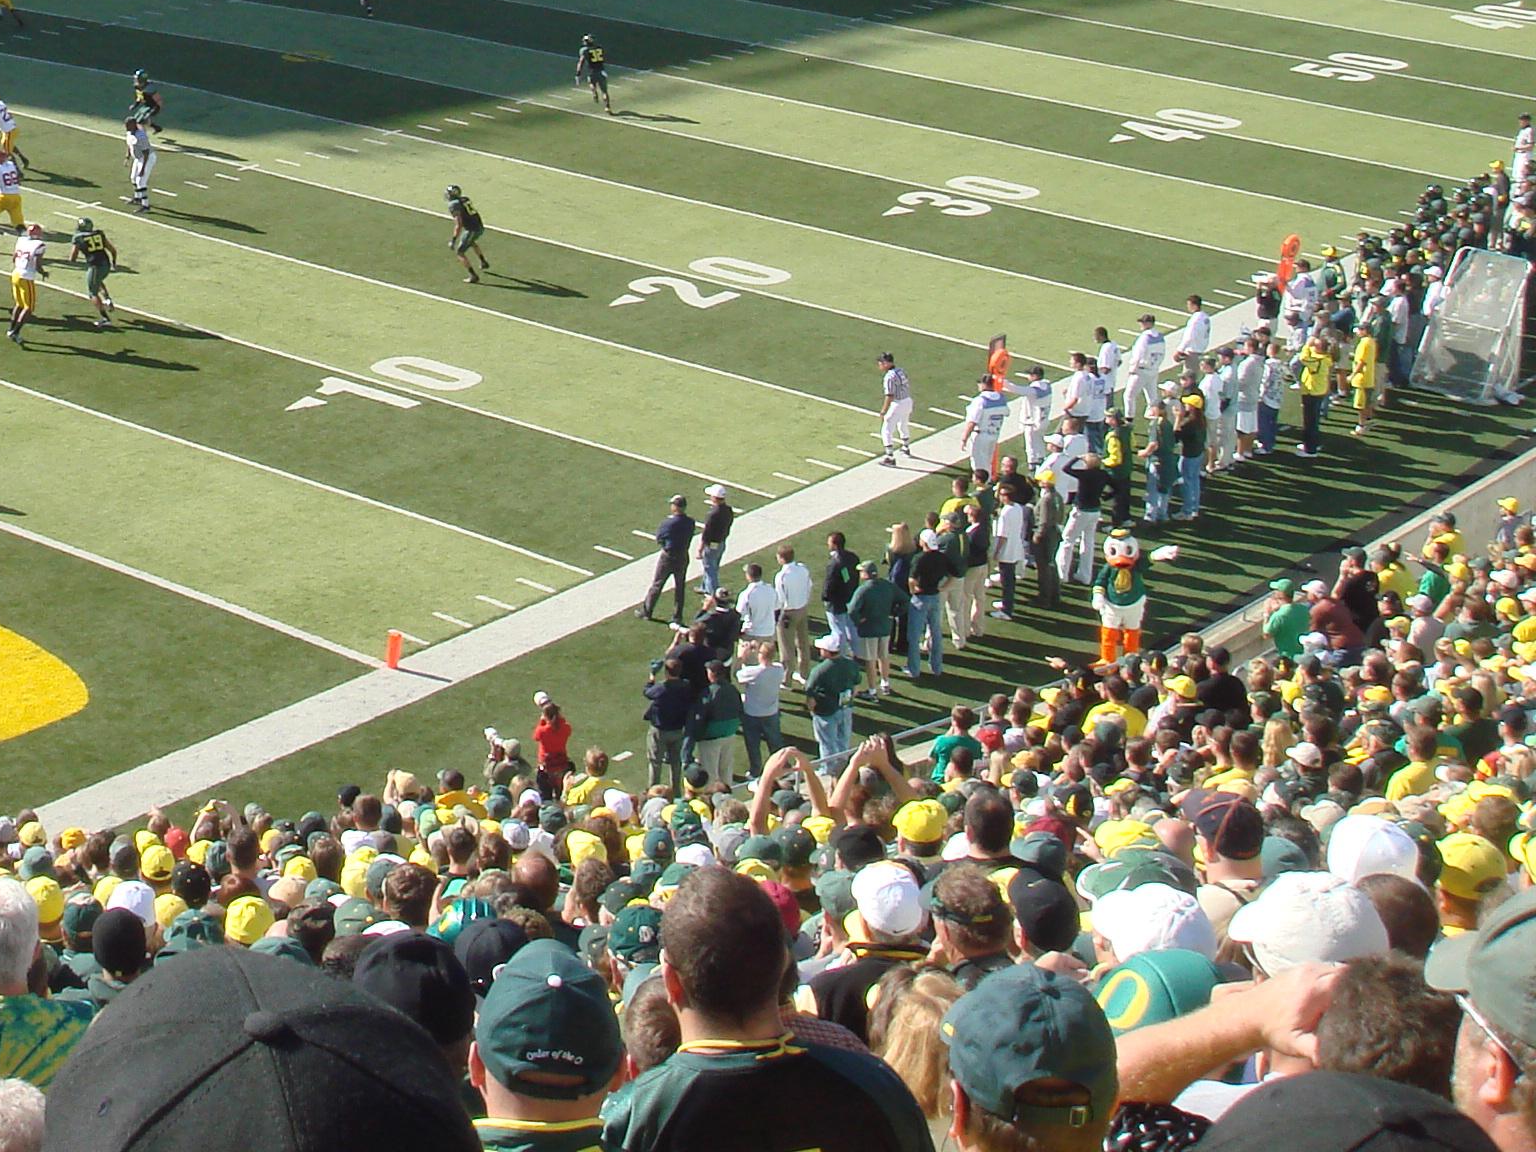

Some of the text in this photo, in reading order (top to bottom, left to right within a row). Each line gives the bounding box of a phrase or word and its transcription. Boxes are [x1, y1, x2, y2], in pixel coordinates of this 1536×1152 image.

[587, 48, 604, 62] 32
[1292, 51, 1409, 84] 50
[1122, 108, 1243, 146] 40
[898, 175, 1041, 218] 30
[83, 233, 104, 253] 39
[629, 256, 791, 311] 20
[317, 355, 482, 409] 10
[526, 1048, 550, 1061] Order
[551, 1049, 563, 1060] of
